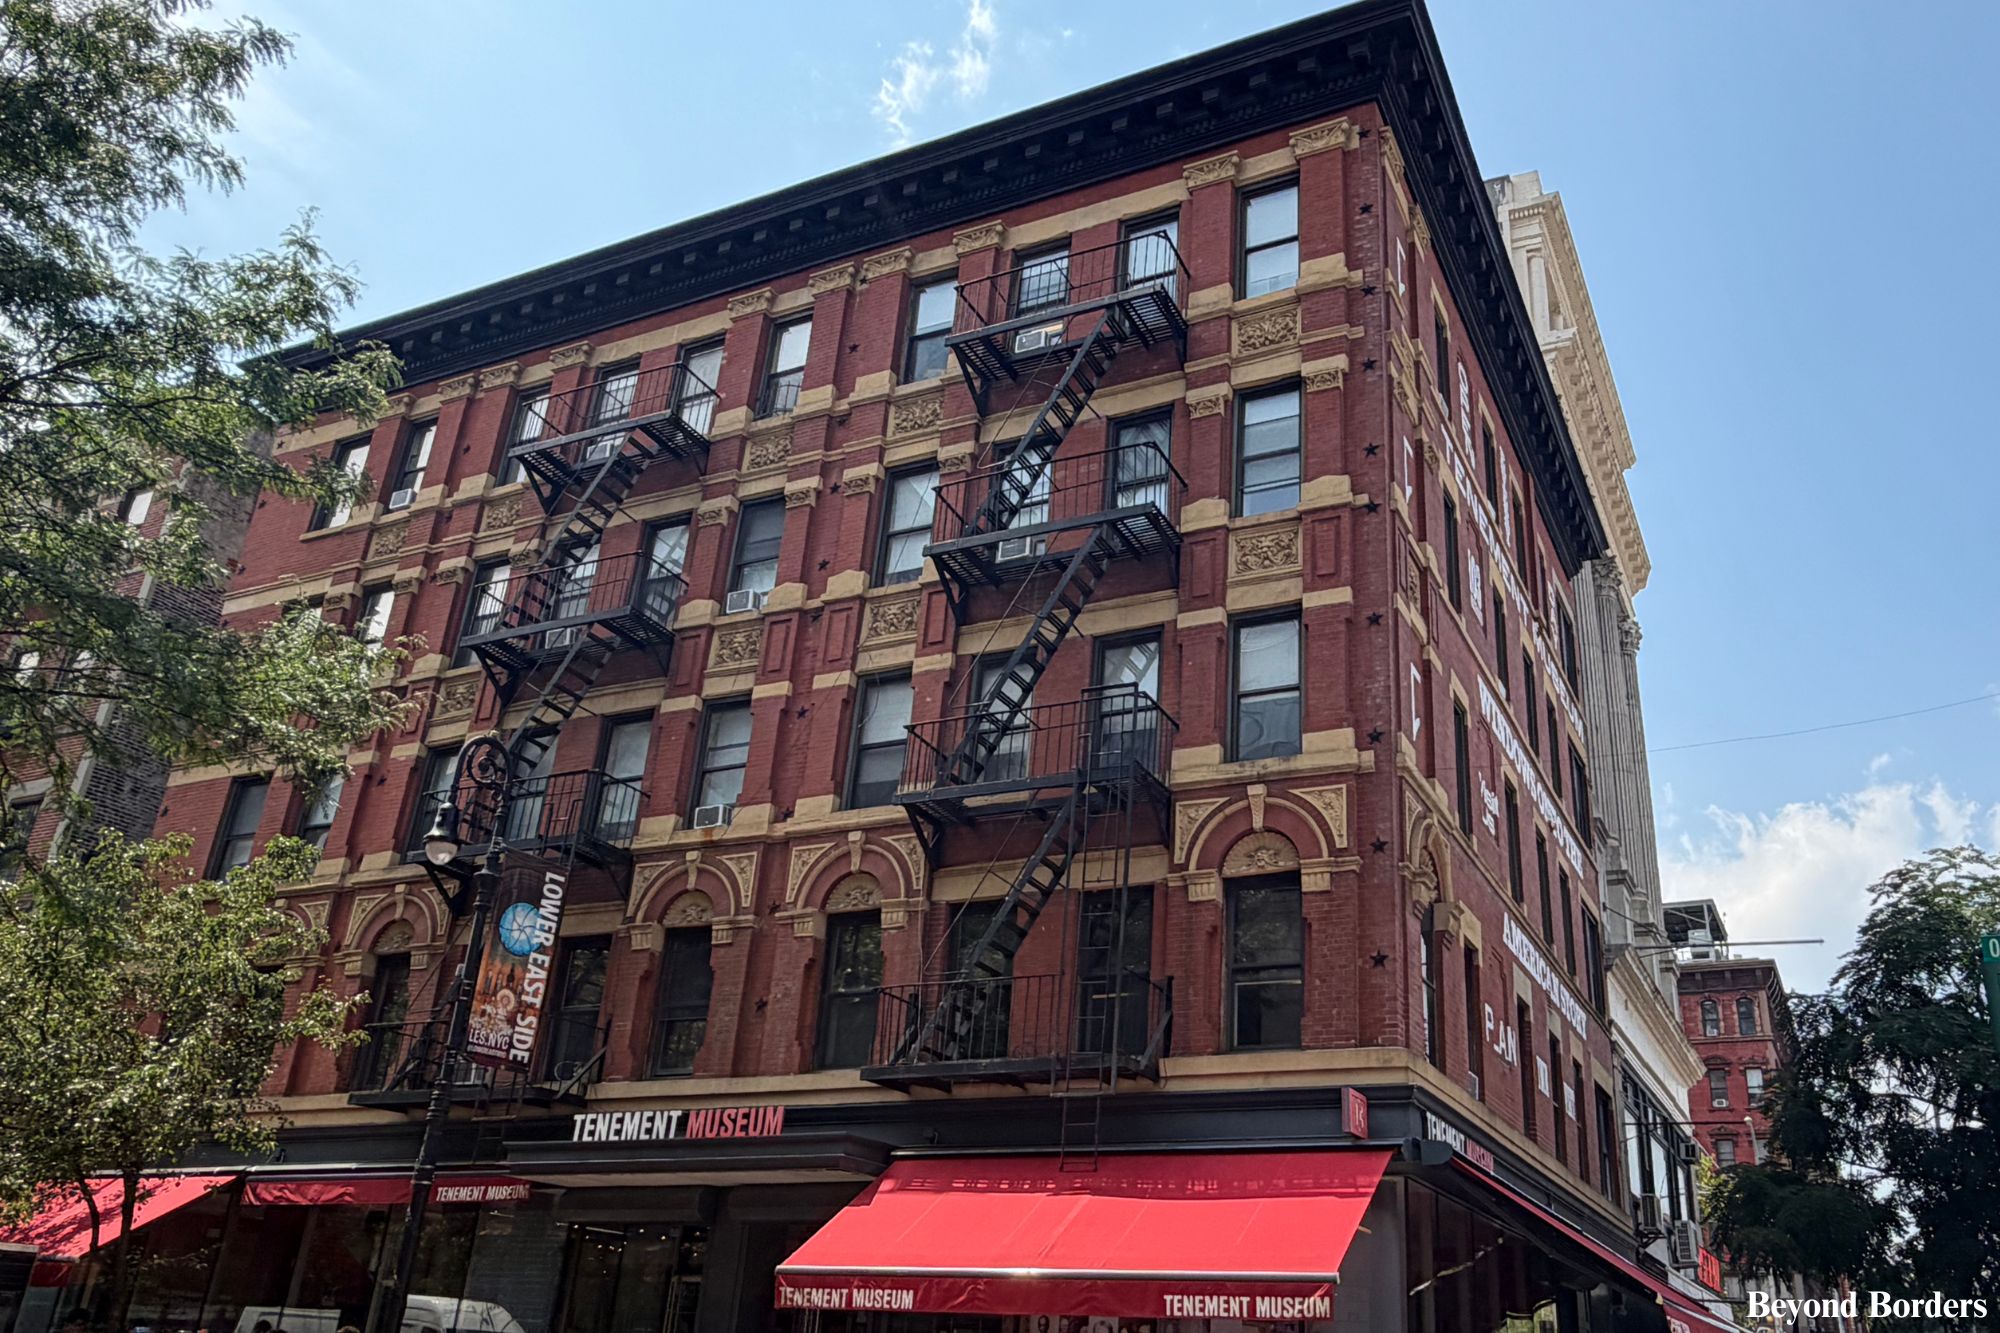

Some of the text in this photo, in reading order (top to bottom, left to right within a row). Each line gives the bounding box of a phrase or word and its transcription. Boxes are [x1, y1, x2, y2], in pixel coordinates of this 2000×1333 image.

[1457, 362, 1475, 470] OPEN
[1441, 424, 1529, 628] TENEMENT
[1477, 674, 1537, 802] WINDOWS
[509, 871, 566, 1063] LOWER EAST SIDE
[1503, 911, 1587, 1041] AMERICAN STORY
[469, 1029, 510, 1050] LES.NYC
[572, 1105, 784, 1142] TENEMENT MUSEUM
[436, 1184, 530, 1202] TENEMENT MUSEUM
[779, 1286, 914, 1310] TENEMENT MUSEUM
[1163, 1294, 1331, 1318] TENEMENT MUSEUM
